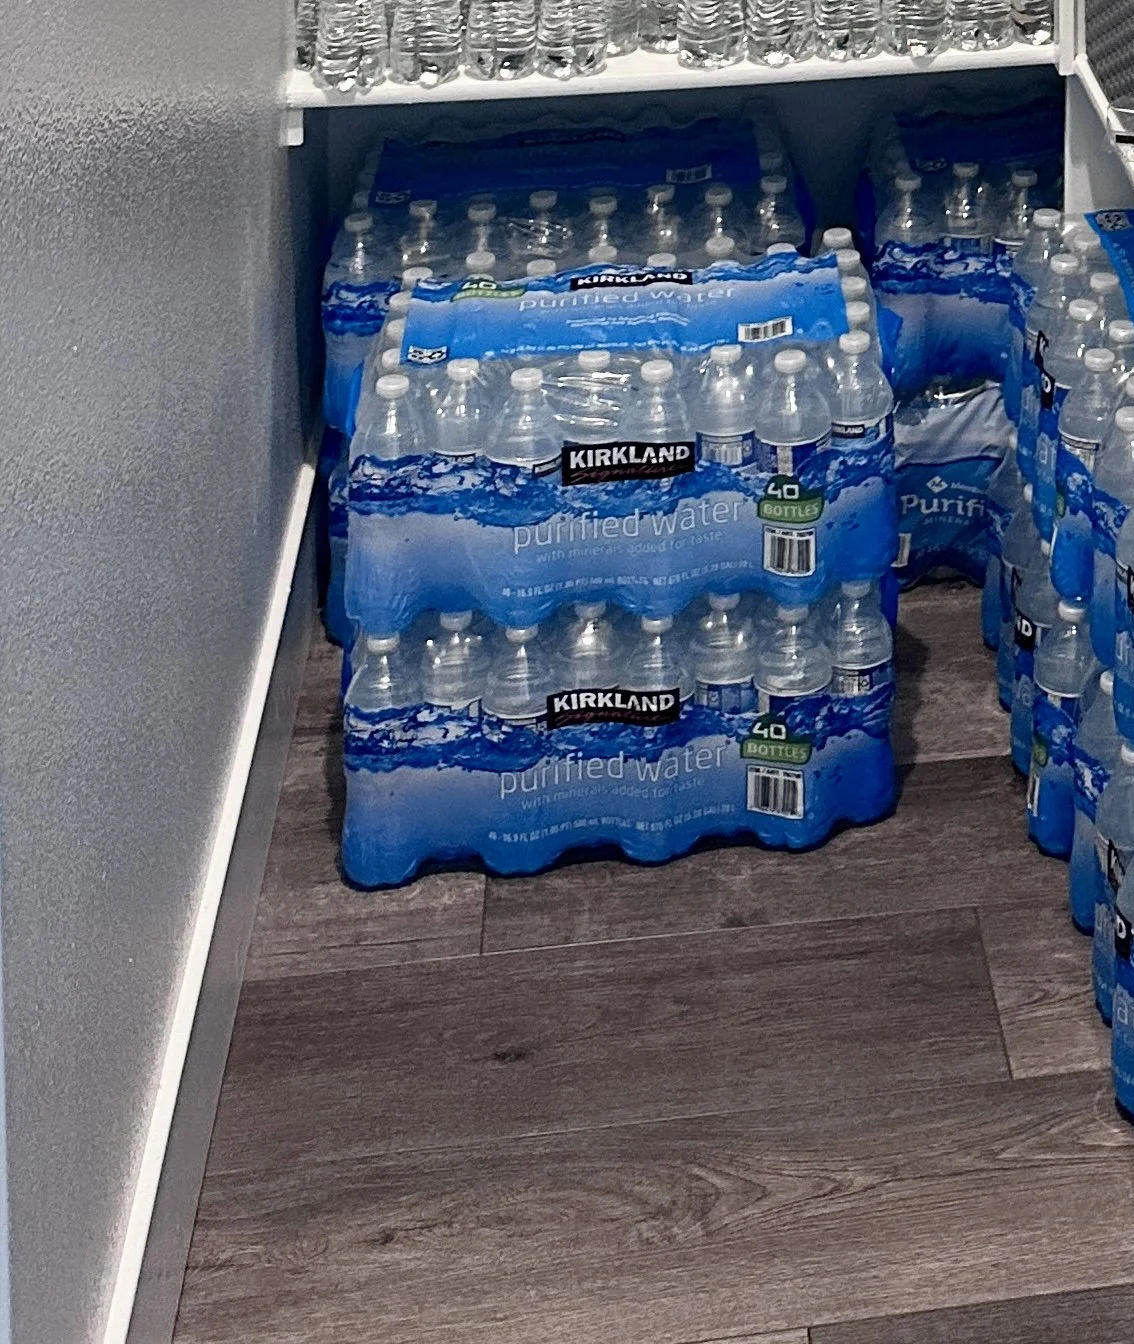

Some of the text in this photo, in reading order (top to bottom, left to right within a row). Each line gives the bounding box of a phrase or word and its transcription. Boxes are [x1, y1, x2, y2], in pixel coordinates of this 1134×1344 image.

[577, 272, 688, 285] KIRKLAND
[520, 286, 736, 312] purified water
[570, 444, 691, 471] KIRKLAND
[767, 484, 800, 500] 40
[763, 502, 820, 518] BOTTLES
[513, 497, 743, 555] purified water
[536, 531, 724, 563] with minerals added for taste
[554, 691, 675, 713] KIRKLAND
[752, 722, 787, 740] 40
[745, 742, 809, 759] BOTTLES
[500, 742, 729, 800] purified water
[522, 790, 550, 810] with
[553, 783, 608, 802] minerals
[611, 782, 650, 799] added
[652, 782, 671, 799] for
